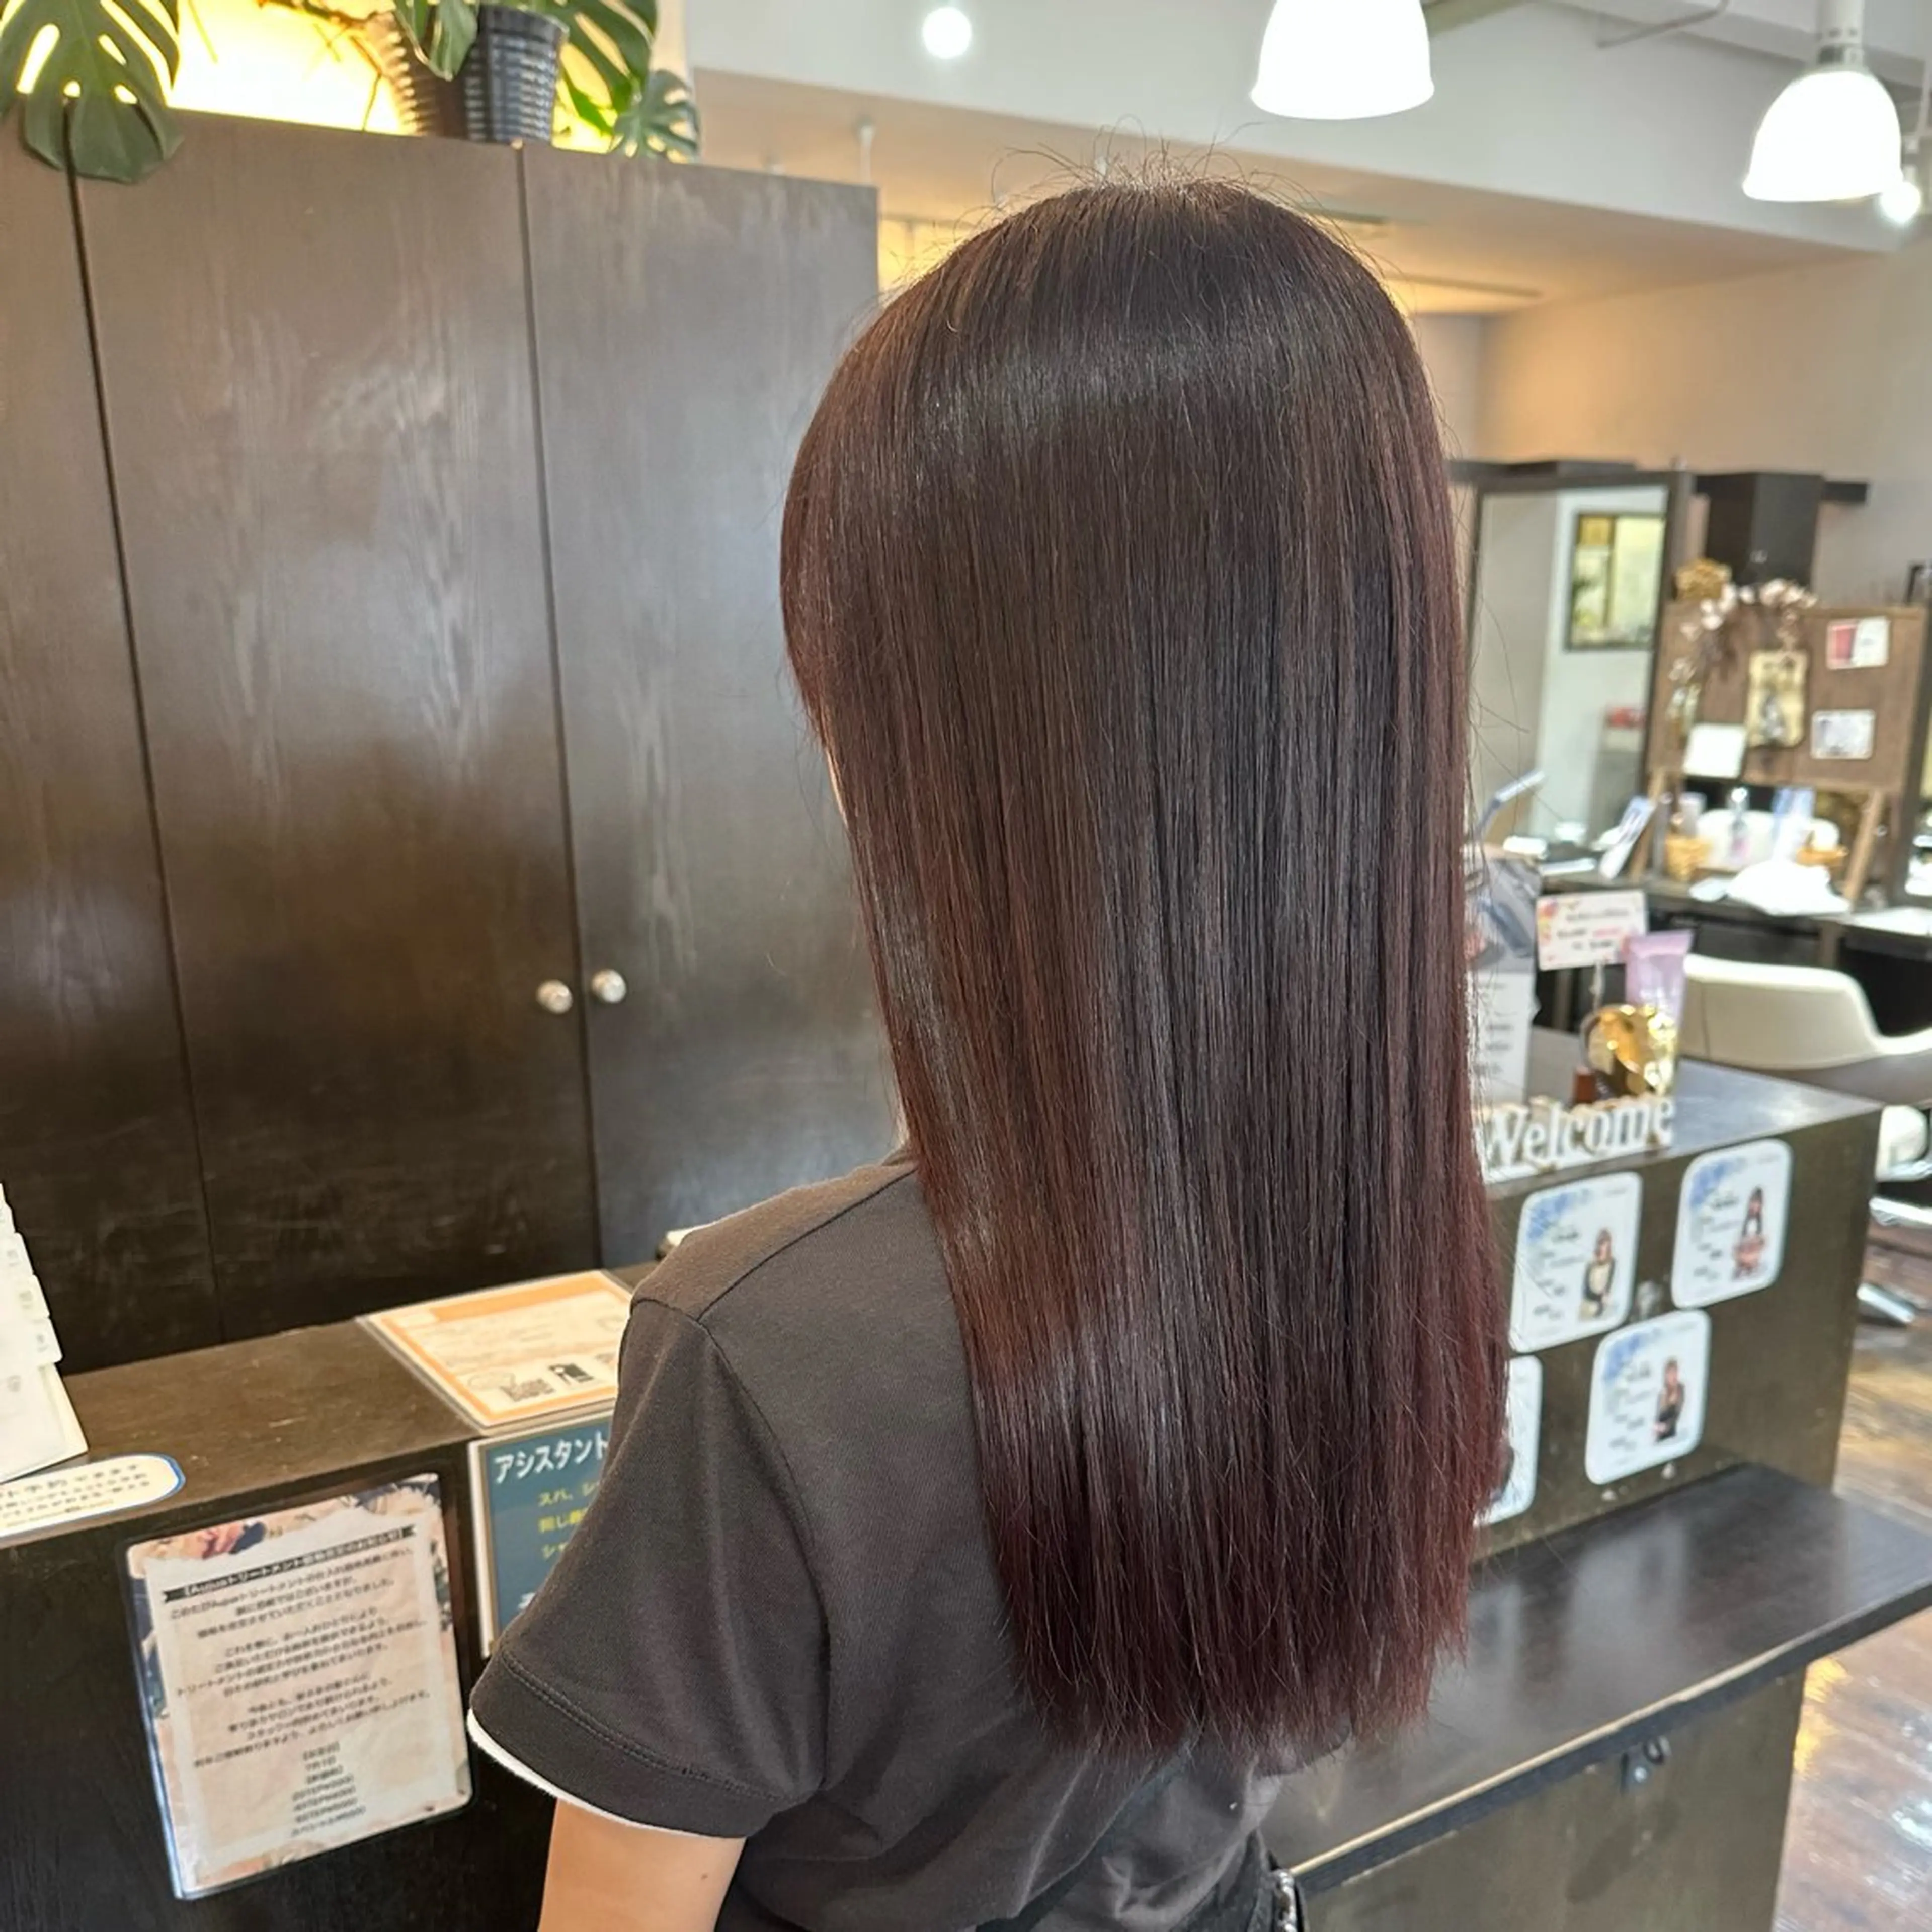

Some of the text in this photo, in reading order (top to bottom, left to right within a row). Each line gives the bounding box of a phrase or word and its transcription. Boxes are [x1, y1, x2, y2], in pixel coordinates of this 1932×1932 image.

[1480, 1097, 1674, 1166] Welcome
[494, 1430, 609, 1484] アシスタント
